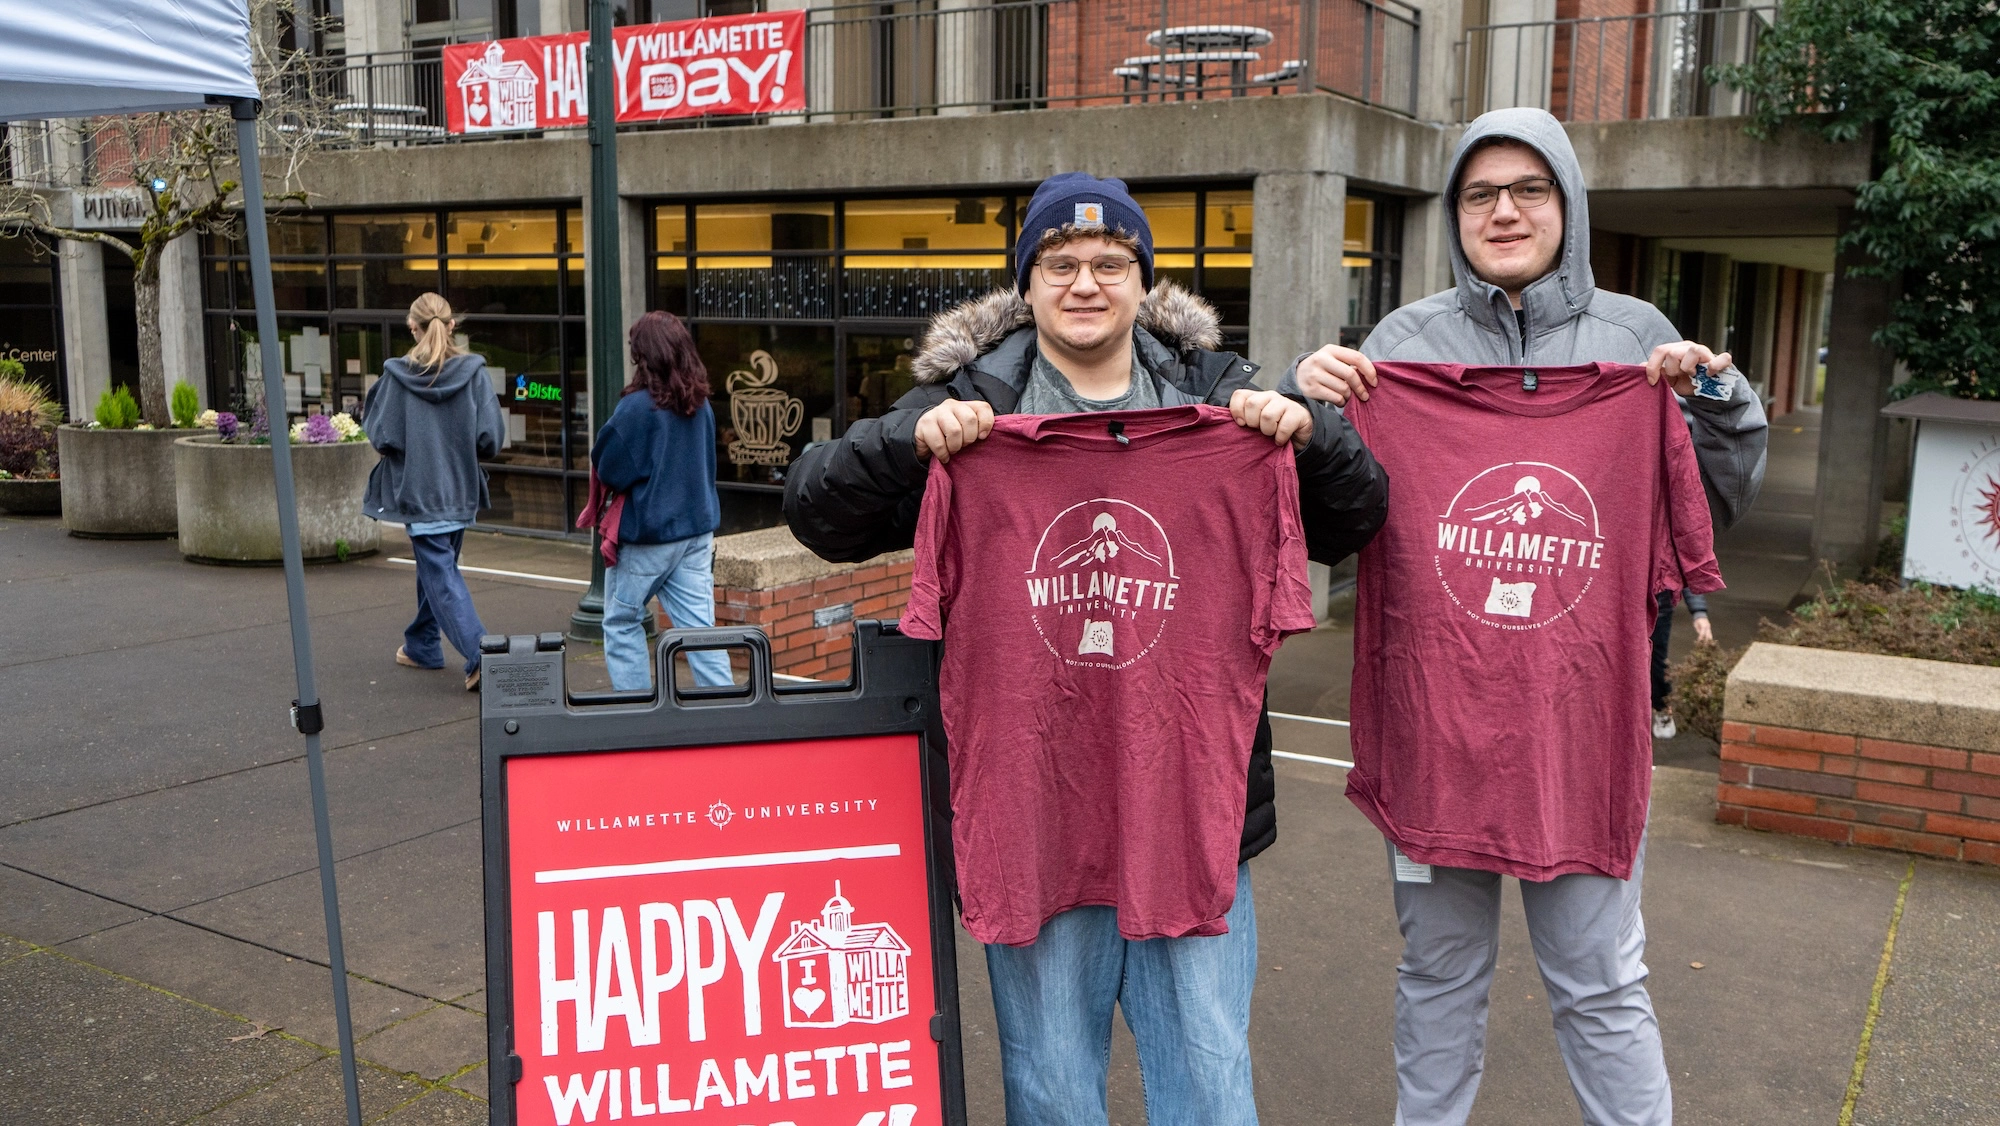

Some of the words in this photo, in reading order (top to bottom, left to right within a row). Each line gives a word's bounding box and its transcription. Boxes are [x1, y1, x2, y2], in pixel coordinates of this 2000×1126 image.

[543, 36, 637, 119] HAY
[637, 21, 784, 62] WILLAMETTE
[651, 75, 674, 85] SINCE
[471, 85, 483, 103] I
[499, 80, 534, 101] WILLA
[651, 84, 675, 97] 1842
[500, 101, 534, 126] METTE
[9, 348, 57, 362] Center
[734, 398, 804, 445] BISTRO
[1438, 522, 1604, 569] WILLAMETTE
[1465, 557, 1564, 577] UNIVERSITY
[1026, 570, 1179, 611] WILLAMETTE
[1441, 580, 1460, 606] OREGON
[1466, 610, 1480, 620] NOT
[1481, 618, 1500, 628] UNTO
[1502, 622, 1541, 631] OURSELVES
[1543, 612, 1563, 626] ALONE
[1563, 603, 1575, 614] ARE
[1574, 594, 1583, 604] WE
[1581, 576, 1594, 594] BORN
[1043, 638, 1059, 658] OREGON
[1137, 648, 1149, 659] ARE
[1149, 638, 1158, 648] WE
[1157, 618, 1167, 638] BORN
[557, 811, 697, 832] WILLAMETTE
[744, 799, 878, 819] UNIVERSITY
[537, 892, 785, 1056] HAPPY
[799, 959, 816, 985] I
[845, 950, 905, 984] WILLA
[847, 980, 907, 1018] METTE
[543, 1040, 913, 1126] WILLAMETTE
